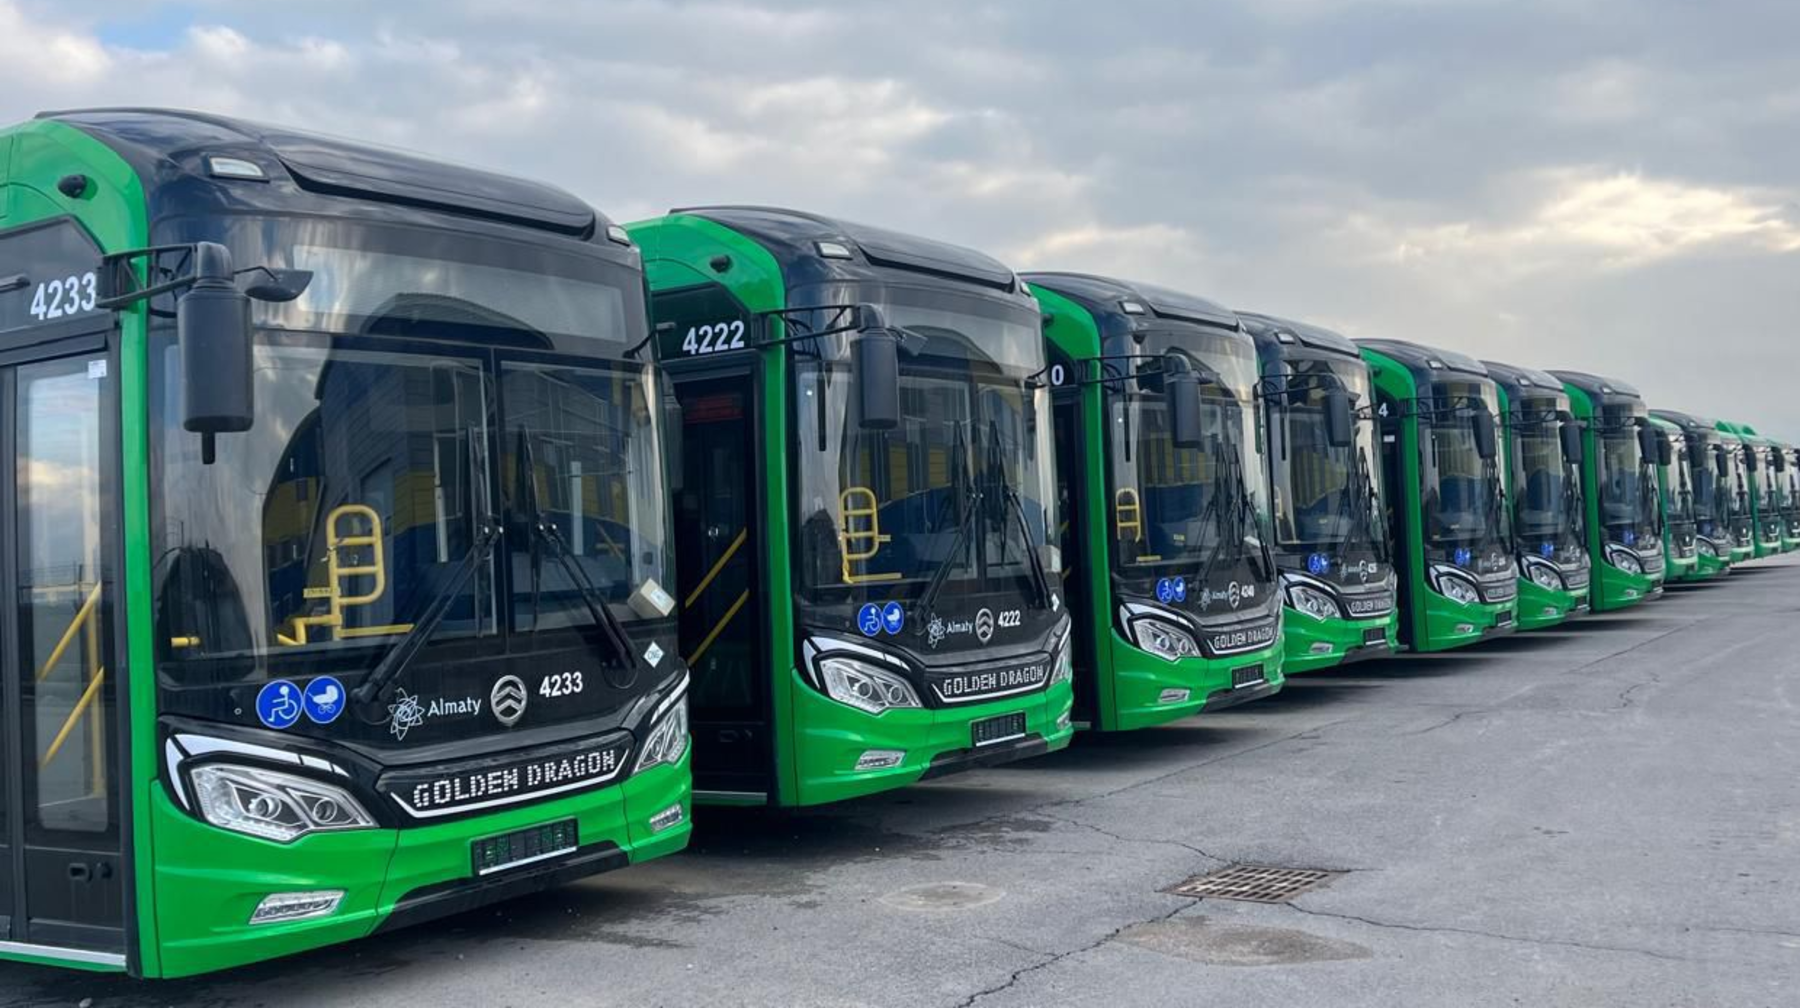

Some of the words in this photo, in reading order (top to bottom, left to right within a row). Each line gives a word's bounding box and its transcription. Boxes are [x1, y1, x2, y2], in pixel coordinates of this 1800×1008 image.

[30, 272, 96, 320] 4233
[682, 320, 745, 355] 4222
[946, 621, 974, 635] Almaty
[998, 610, 1021, 628] 4222
[1213, 632, 1246, 649] GOLDEN
[539, 671, 583, 698] 4233
[943, 673, 997, 696] GOLDEN
[1000, 665, 1044, 687] DRAGON
[427, 696, 482, 717] Almaty
[413, 768, 519, 808] GOLDEN
[527, 749, 615, 786] DRAGON
